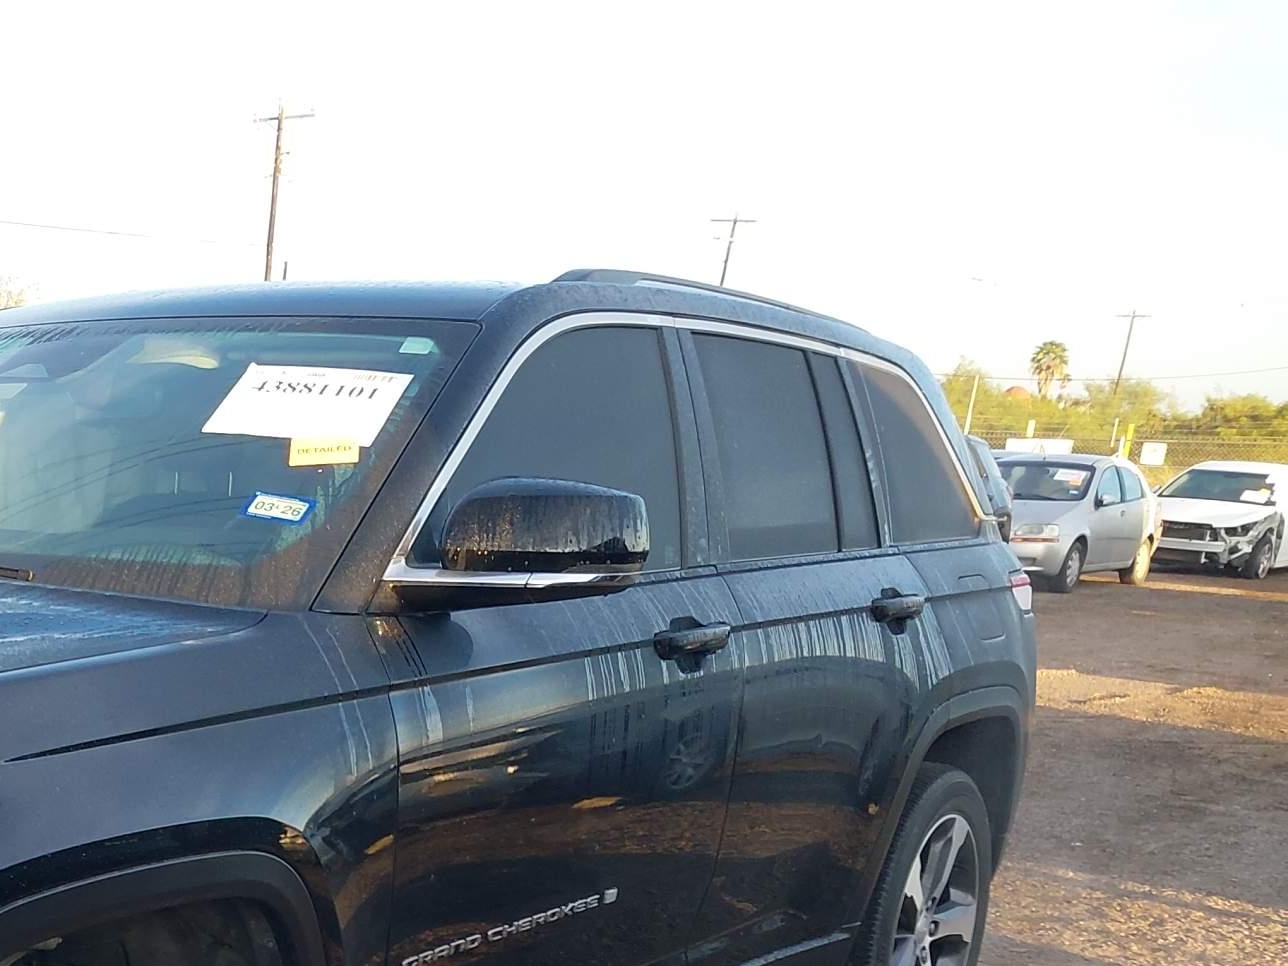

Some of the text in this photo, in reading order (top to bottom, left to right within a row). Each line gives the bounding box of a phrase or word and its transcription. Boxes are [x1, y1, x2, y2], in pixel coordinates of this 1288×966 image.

[252, 380, 379, 400] 43881101
[297, 446, 353, 456] DETAILED
[487, 894, 600, 943] CHEROKEE
